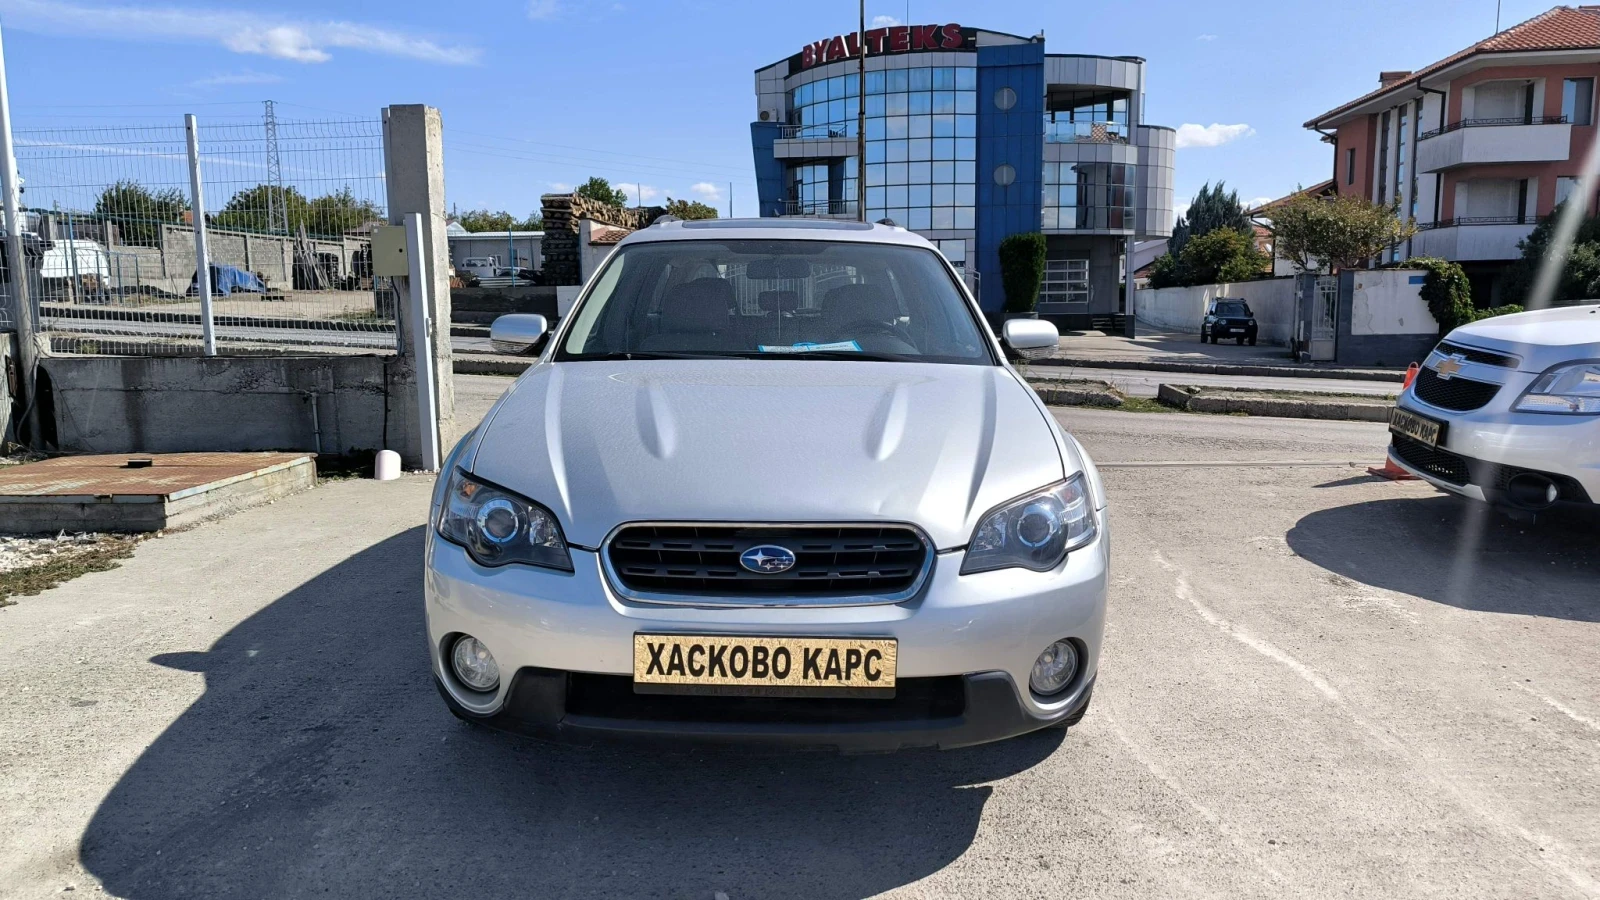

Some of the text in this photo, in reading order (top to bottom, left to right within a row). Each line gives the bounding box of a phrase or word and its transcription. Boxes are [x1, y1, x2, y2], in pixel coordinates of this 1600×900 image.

[802, 23, 963, 68] BYALTEKS
[646, 643, 882, 681] ХАСКОВО КАРС
